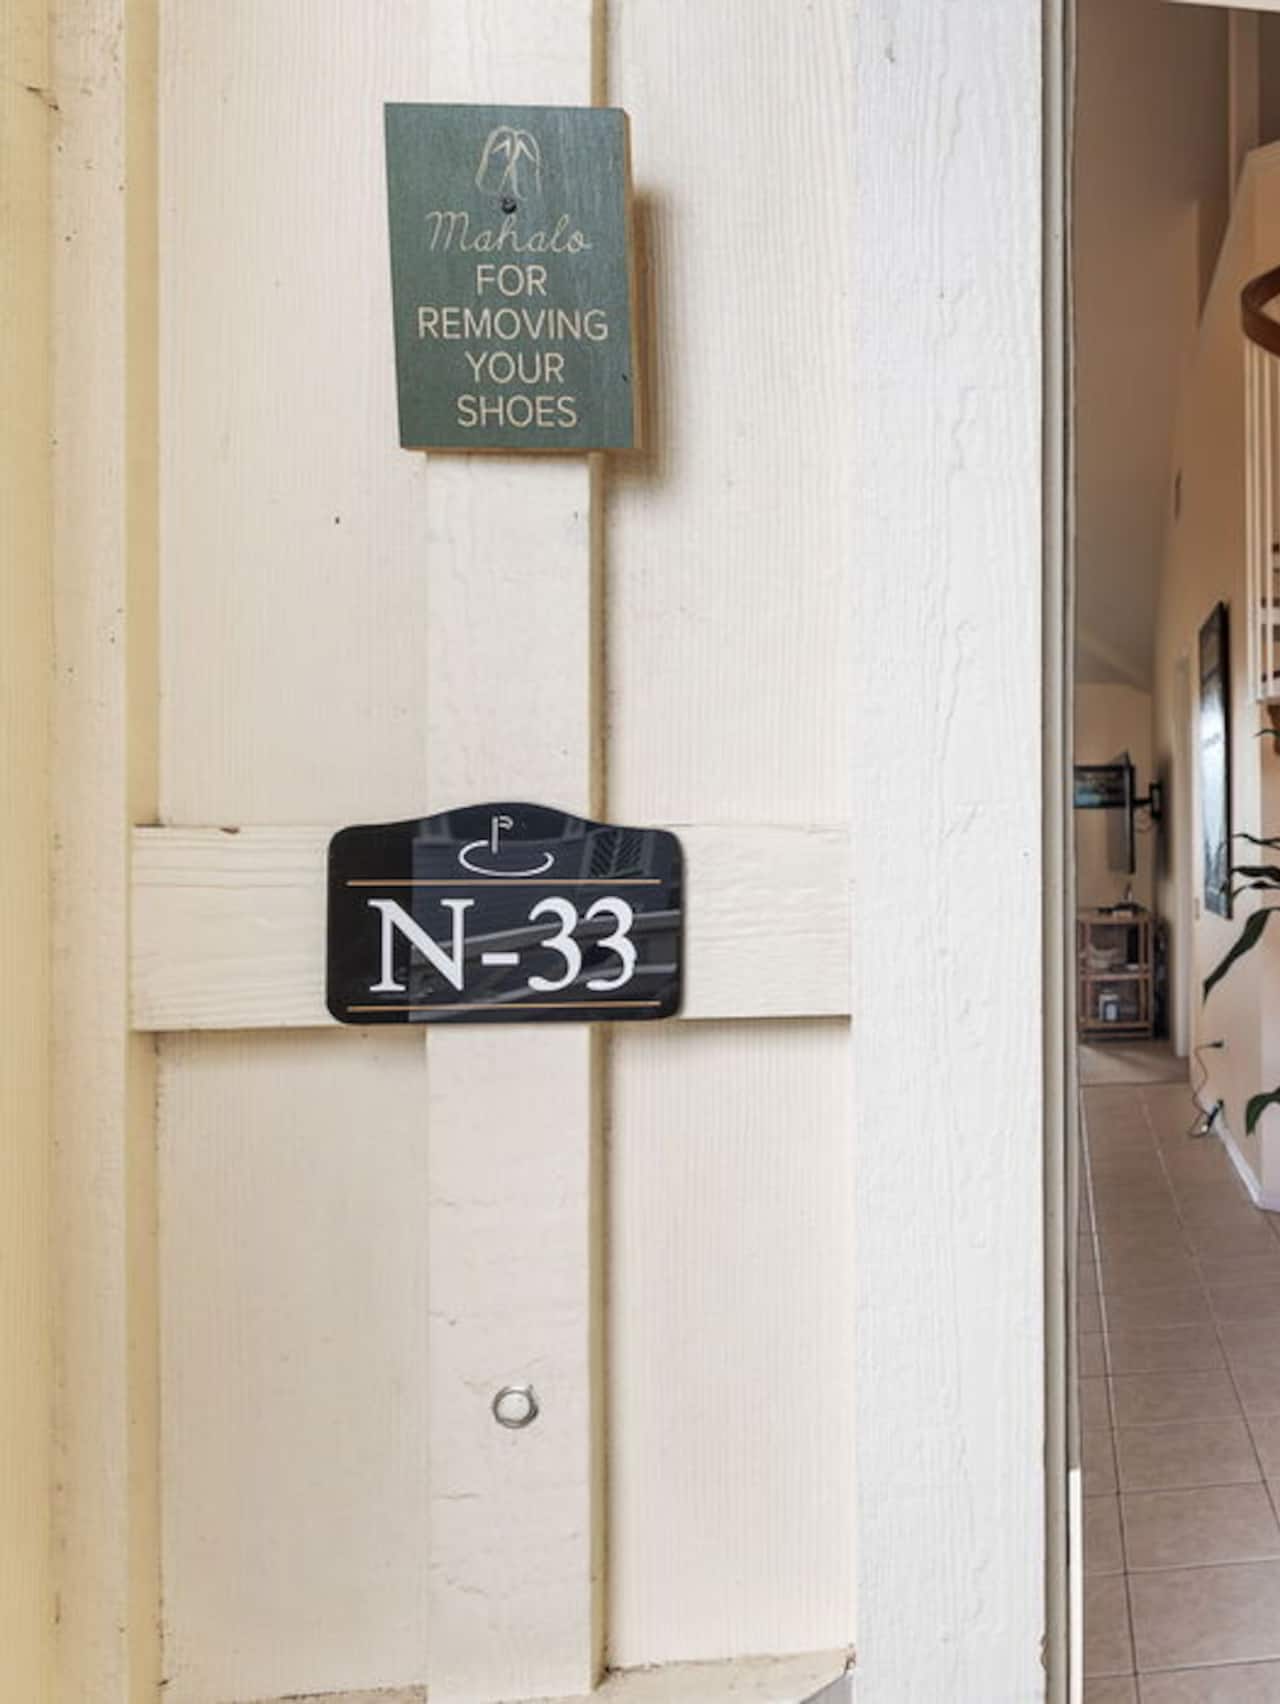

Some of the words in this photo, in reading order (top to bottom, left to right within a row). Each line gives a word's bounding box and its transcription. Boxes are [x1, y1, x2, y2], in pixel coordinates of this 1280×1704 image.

[425, 210, 592, 253] Mahalo
[475, 264, 548, 296] FOR
[417, 307, 609, 341] REMOVING
[465, 351, 565, 384] YOUR
[456, 395, 577, 428] SHOES
[367, 896, 638, 992] N-33
